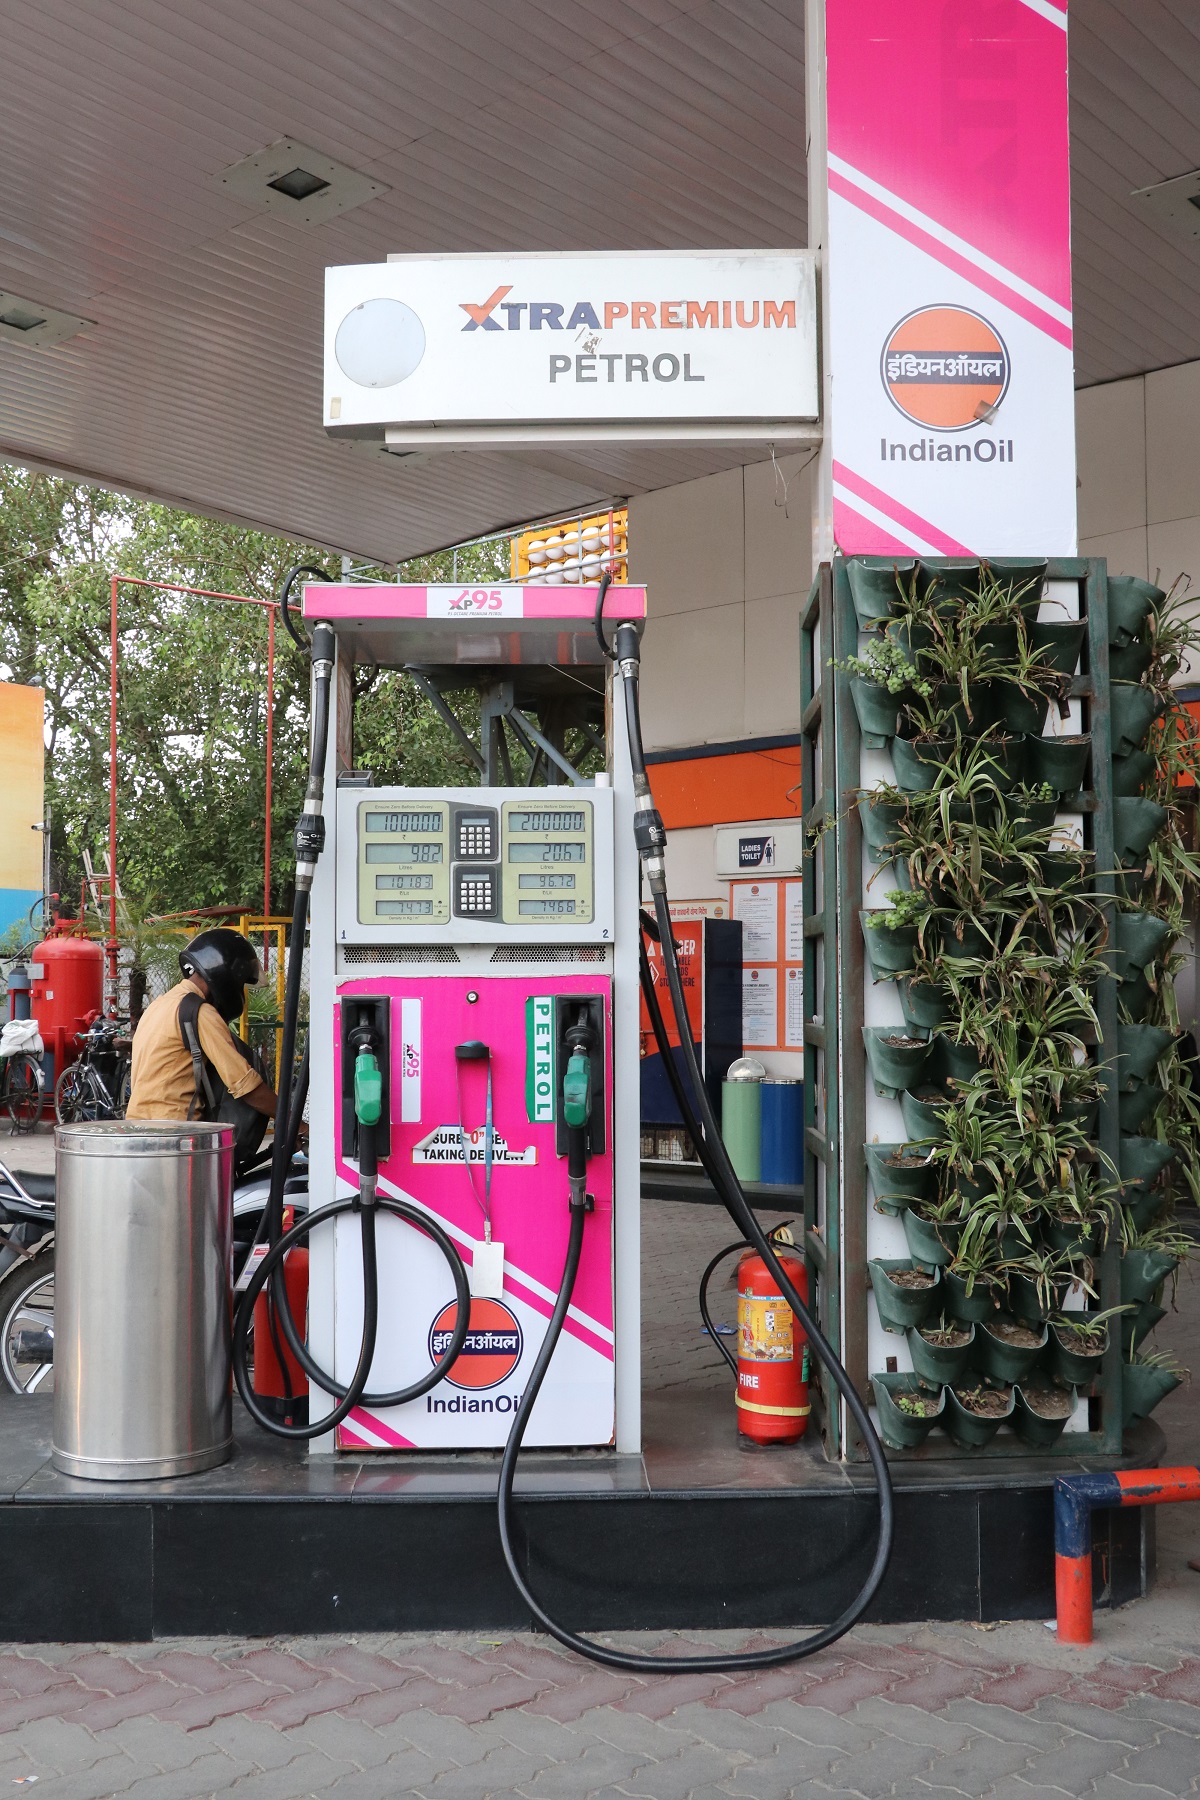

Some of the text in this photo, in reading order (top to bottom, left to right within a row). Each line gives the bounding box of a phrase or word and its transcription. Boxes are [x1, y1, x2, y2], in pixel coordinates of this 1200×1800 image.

[550, 353, 705, 383] PETROL
[887, 354, 1002, 381] इंडियनऑयल
[880, 438, 1014, 462] IndianOil
[448, 590, 503, 610] XP95
[384, 814, 441, 832] 1000.00
[521, 813, 583, 831] 2000.00
[741, 844, 761, 852] LADIES
[741, 852, 761, 860] TOILET
[539, 875, 573, 887] 96.72
[341, 930, 346, 940] 1
[602, 929, 609, 939] 2
[536, 1004, 551, 1115] PETROL
[432, 1133, 463, 1144] SURE
[422, 1149, 465, 1160] TAKING
[740, 1373, 759, 1389] FIRE
[427, 1395, 523, 1413] IndianOi
